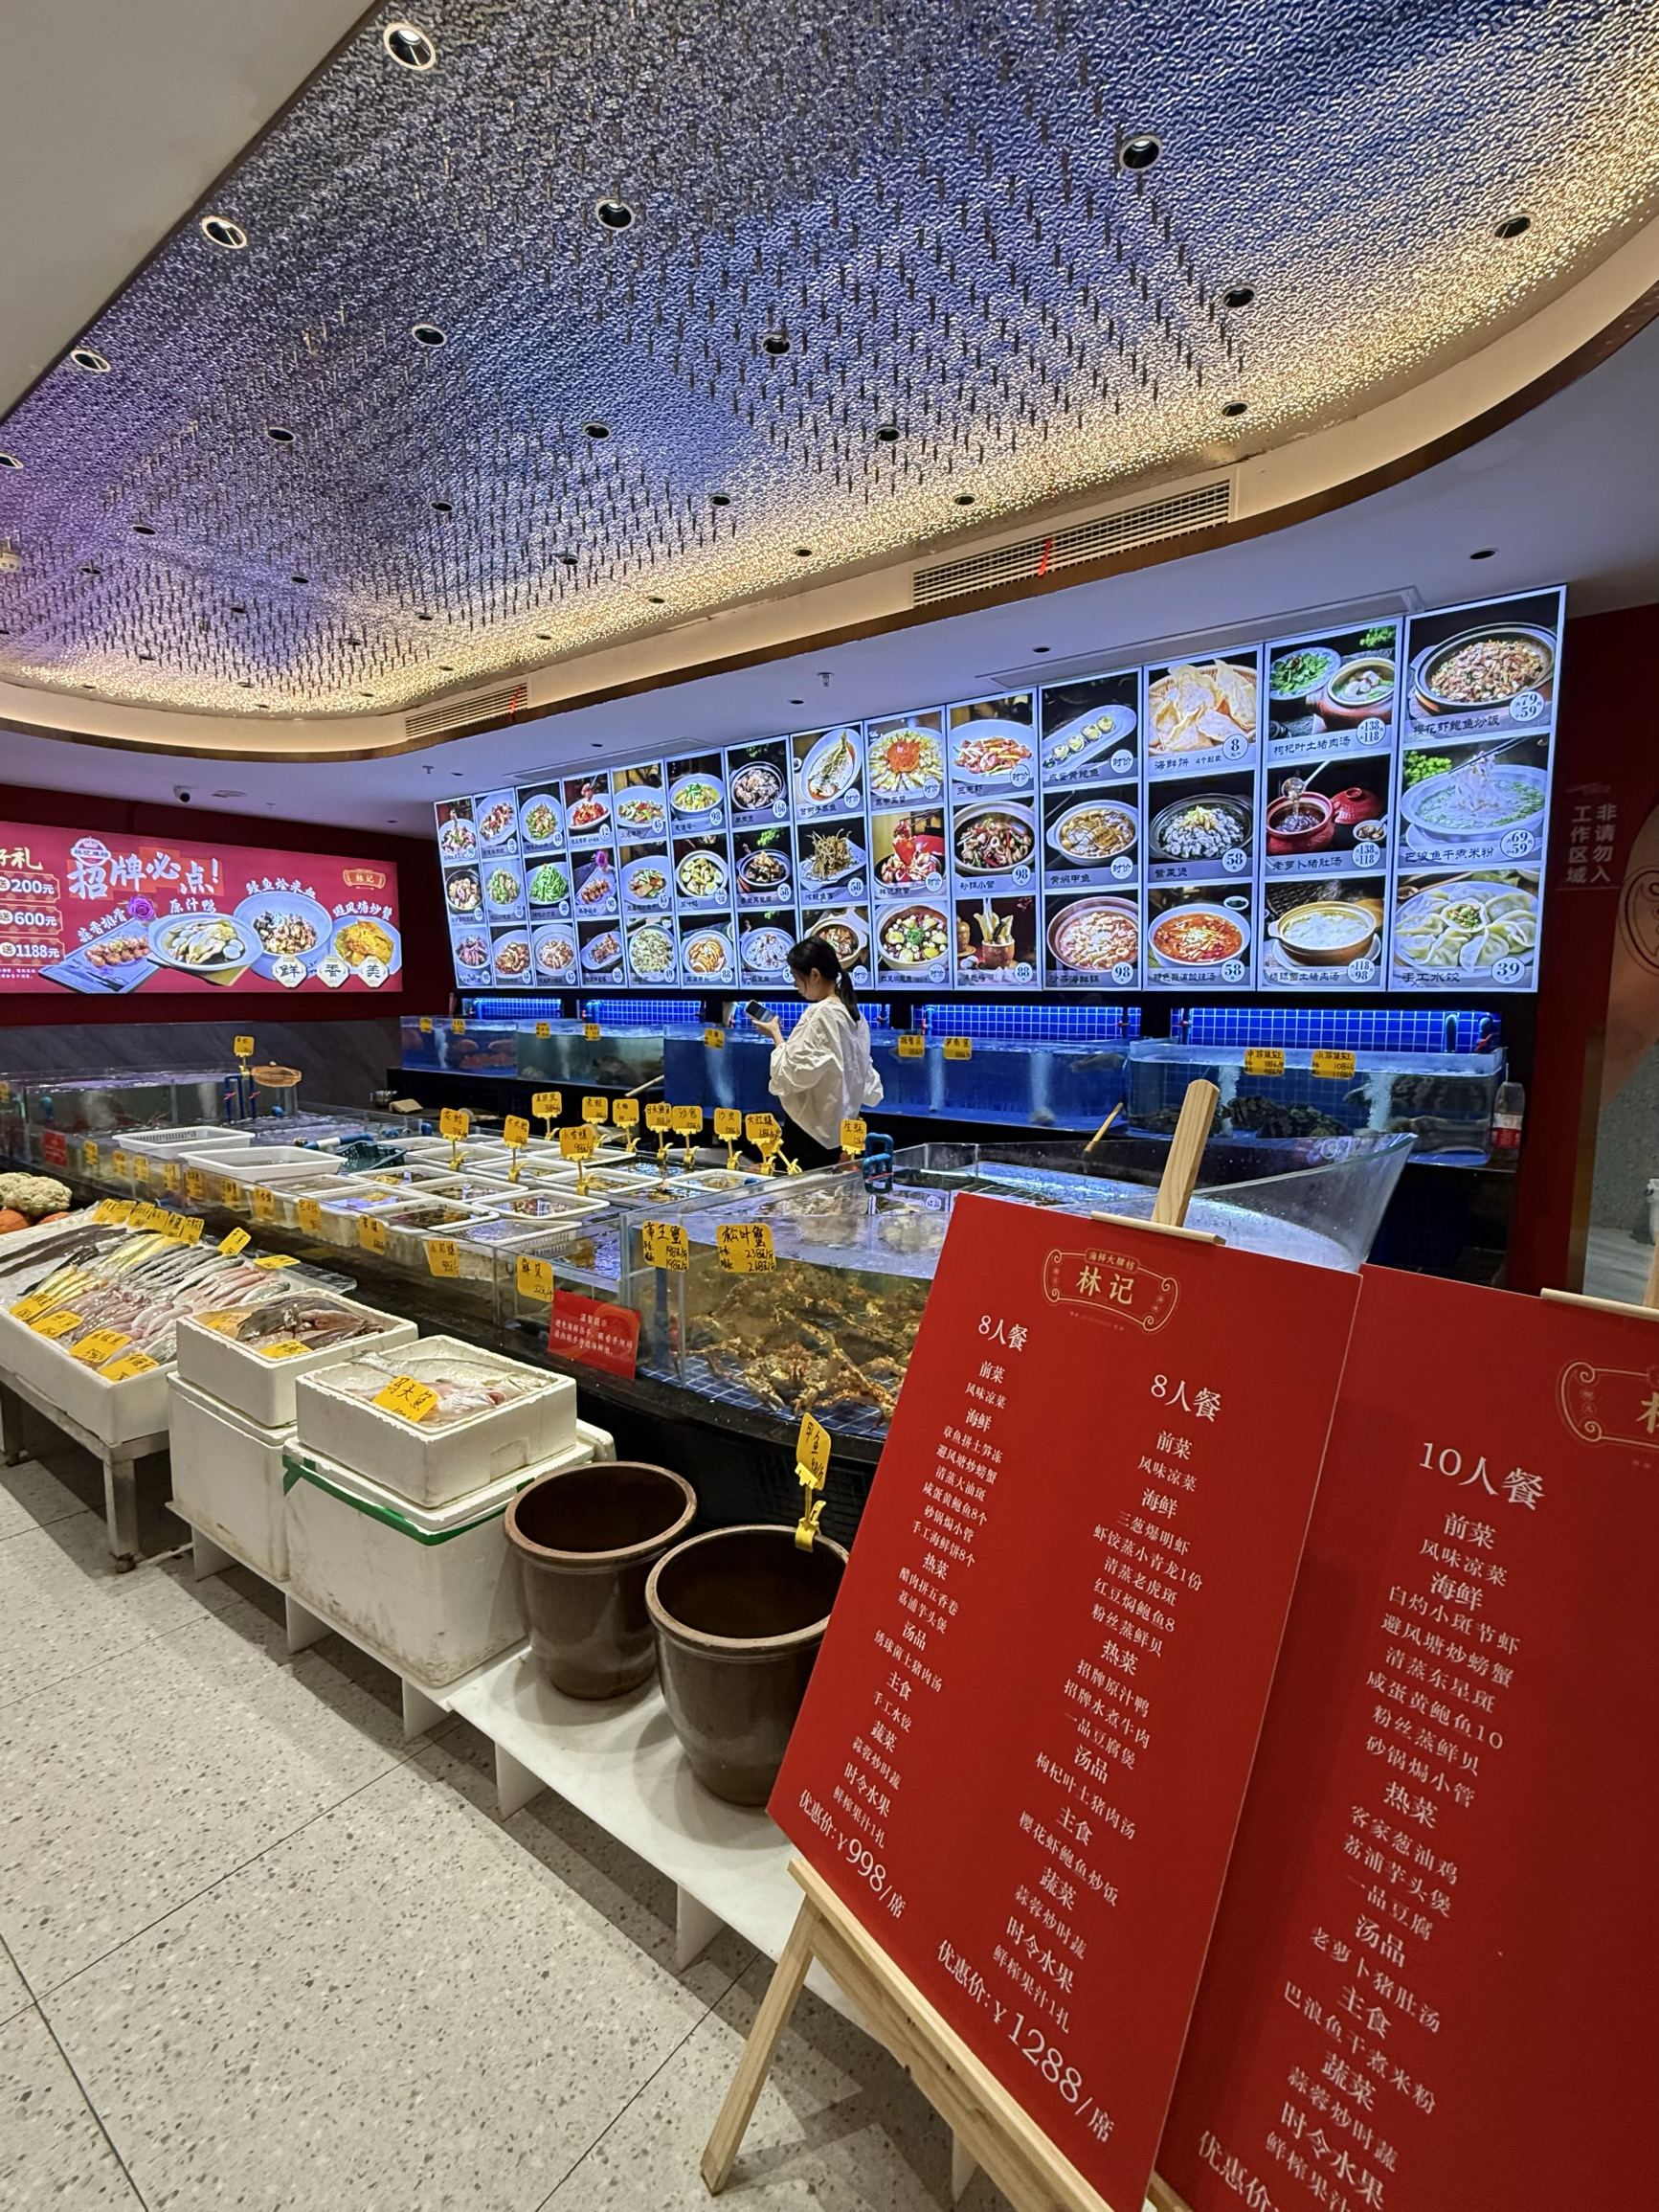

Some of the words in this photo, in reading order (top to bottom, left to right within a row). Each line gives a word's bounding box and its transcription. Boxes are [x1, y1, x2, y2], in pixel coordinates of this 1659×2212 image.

[1230, 738, 1240, 752] 8
[1226, 853, 1243, 866] 58
[1511, 831, 1528, 843] 69
[1512, 843, 1528, 855] 59
[1565, 805, 1592, 884] 工作区域
[1590, 803, 1618, 883] 非请勿入
[355, 873, 375, 884] 林记
[1015, 869, 1028, 880] 98
[169, 897, 216, 914] 原汁鸭
[279, 964, 301, 978] 鲜
[325, 963, 342, 977] 香
[366, 964, 381, 978] 美
[1017, 966, 1030, 977] 88
[1114, 965, 1131, 978] 98
[1224, 964, 1242, 976] 58
[1355, 970, 1368, 981] 98
[1401, 972, 1461, 982] 手工水饺
[1496, 962, 1520, 977] 39
[643, 1222, 682, 1245] 帝王蟹
[722, 1225, 766, 1248] 松叶蟹
[1075, 1265, 1134, 1305] 林记
[977, 1315, 1028, 1352] 8人餐
[978, 1360, 1006, 1384] 前菜
[964, 1382, 1007, 1410] 风味凉菜
[1150, 1373, 1222, 1424] 8人餐
[965, 1408, 992, 1433] 海鲜
[935, 1443, 998, 1485] 避风塘炒螃蟹
[942, 1425, 1003, 1464] 章鱼拼土笋冻
[1155, 1430, 1193, 1461] 前菜
[1137, 1455, 1199, 1493] 风味凉菜
[1419, 1441, 1546, 1511] 10人餐
[922, 1481, 988, 1526] 咸蛋黄鲍鱼8个
[924, 1503, 975, 1544] 砂锅焗小管
[1141, 1487, 1178, 1520] 海鲜
[911, 1520, 975, 1568] 手工海鲜饼8个
[1115, 1510, 1192, 1557] 三葱爆明虾
[1444, 1511, 1497, 1550] 前菜
[924, 1551, 948, 1580] 热菜
[1092, 1524, 1203, 1591] 虾饺蒸小青龙1份
[1103, 1554, 1177, 1608] 清蒸老虎斑
[1419, 1538, 1509, 1588] 风味凉菜
[898, 1590, 948, 1635] 荔浦芋头煲
[1093, 1577, 1177, 1634] 红豆焖鲍鱼8
[1430, 1570, 1485, 1613] 海鲜
[902, 1620, 927, 1651] 汤品
[1090, 1603, 1164, 1659] 粉丝蒸鲜贝
[1389, 1584, 1521, 1657] 白灼小斑节虾
[873, 1629, 943, 1692] 绣球菌土猪肉汤
[1101, 1638, 1139, 1676] 热菜
[1380, 1613, 1514, 1689] 避风塘炒螃蟹
[886, 1671, 912, 1702] 主食
[1077, 1659, 1151, 1719] 招牌原汁鸭
[1384, 1645, 1495, 1715] 清蒸东星斑
[872, 1690, 912, 1733] 手工水饺
[1064, 1678, 1151, 1750] 招牌水煮牛肉
[1365, 1669, 1504, 1750] 咸蛋黄鲍鱼10
[870, 1720, 897, 1754] 蔬菜
[1065, 1711, 1137, 1772] 一品豆腐煲
[1371, 1704, 1480, 1777] 粉丝蒸鲜贝
[851, 1734, 902, 1791] 蒜蓉炒时蔬
[1073, 1743, 1110, 1785] 汤品
[1365, 1735, 1475, 1810] 砂锅焗小管
[843, 1761, 891, 1818] 时令水果
[1035, 1750, 1136, 1840] 枸杞叶土猪肉汤
[1383, 1780, 1439, 1830] 热菜
[831, 1784, 886, 1850] 鲜榨果汁1扎
[1055, 1805, 1094, 1847] 主食
[1018, 1810, 1119, 1907] 樱花虾鲍鱼炒饭
[1350, 1804, 1459, 1886] 客家葱油鸡
[1039, 1864, 1075, 1912] 蔬菜
[1343, 1833, 1452, 1918] 荔浦芋头煲
[1013, 1884, 1087, 1960] 蒜蓉炒时蔬
[1344, 1873, 1434, 1942] 一品豆腐
[1005, 1915, 1075, 1994] 时令水果
[1354, 1913, 1406, 1969] 汤品
[992, 1943, 1070, 2035] 鲜榨果汁1扎
[1311, 1926, 1442, 2034] 老萝卜猪肚汤
[1337, 1985, 1393, 2040] 主食
[1284, 1980, 1436, 2115] 巴浪鱼干煮米粉
[1320, 2052, 1377, 2112] 蔬菜
[1287, 2065, 1400, 2174] 蒜蓉炒时蔬
[1198, 2129, 1280, 2212] 优惠价
[1280, 2101, 1384, 2211] 时令水果
